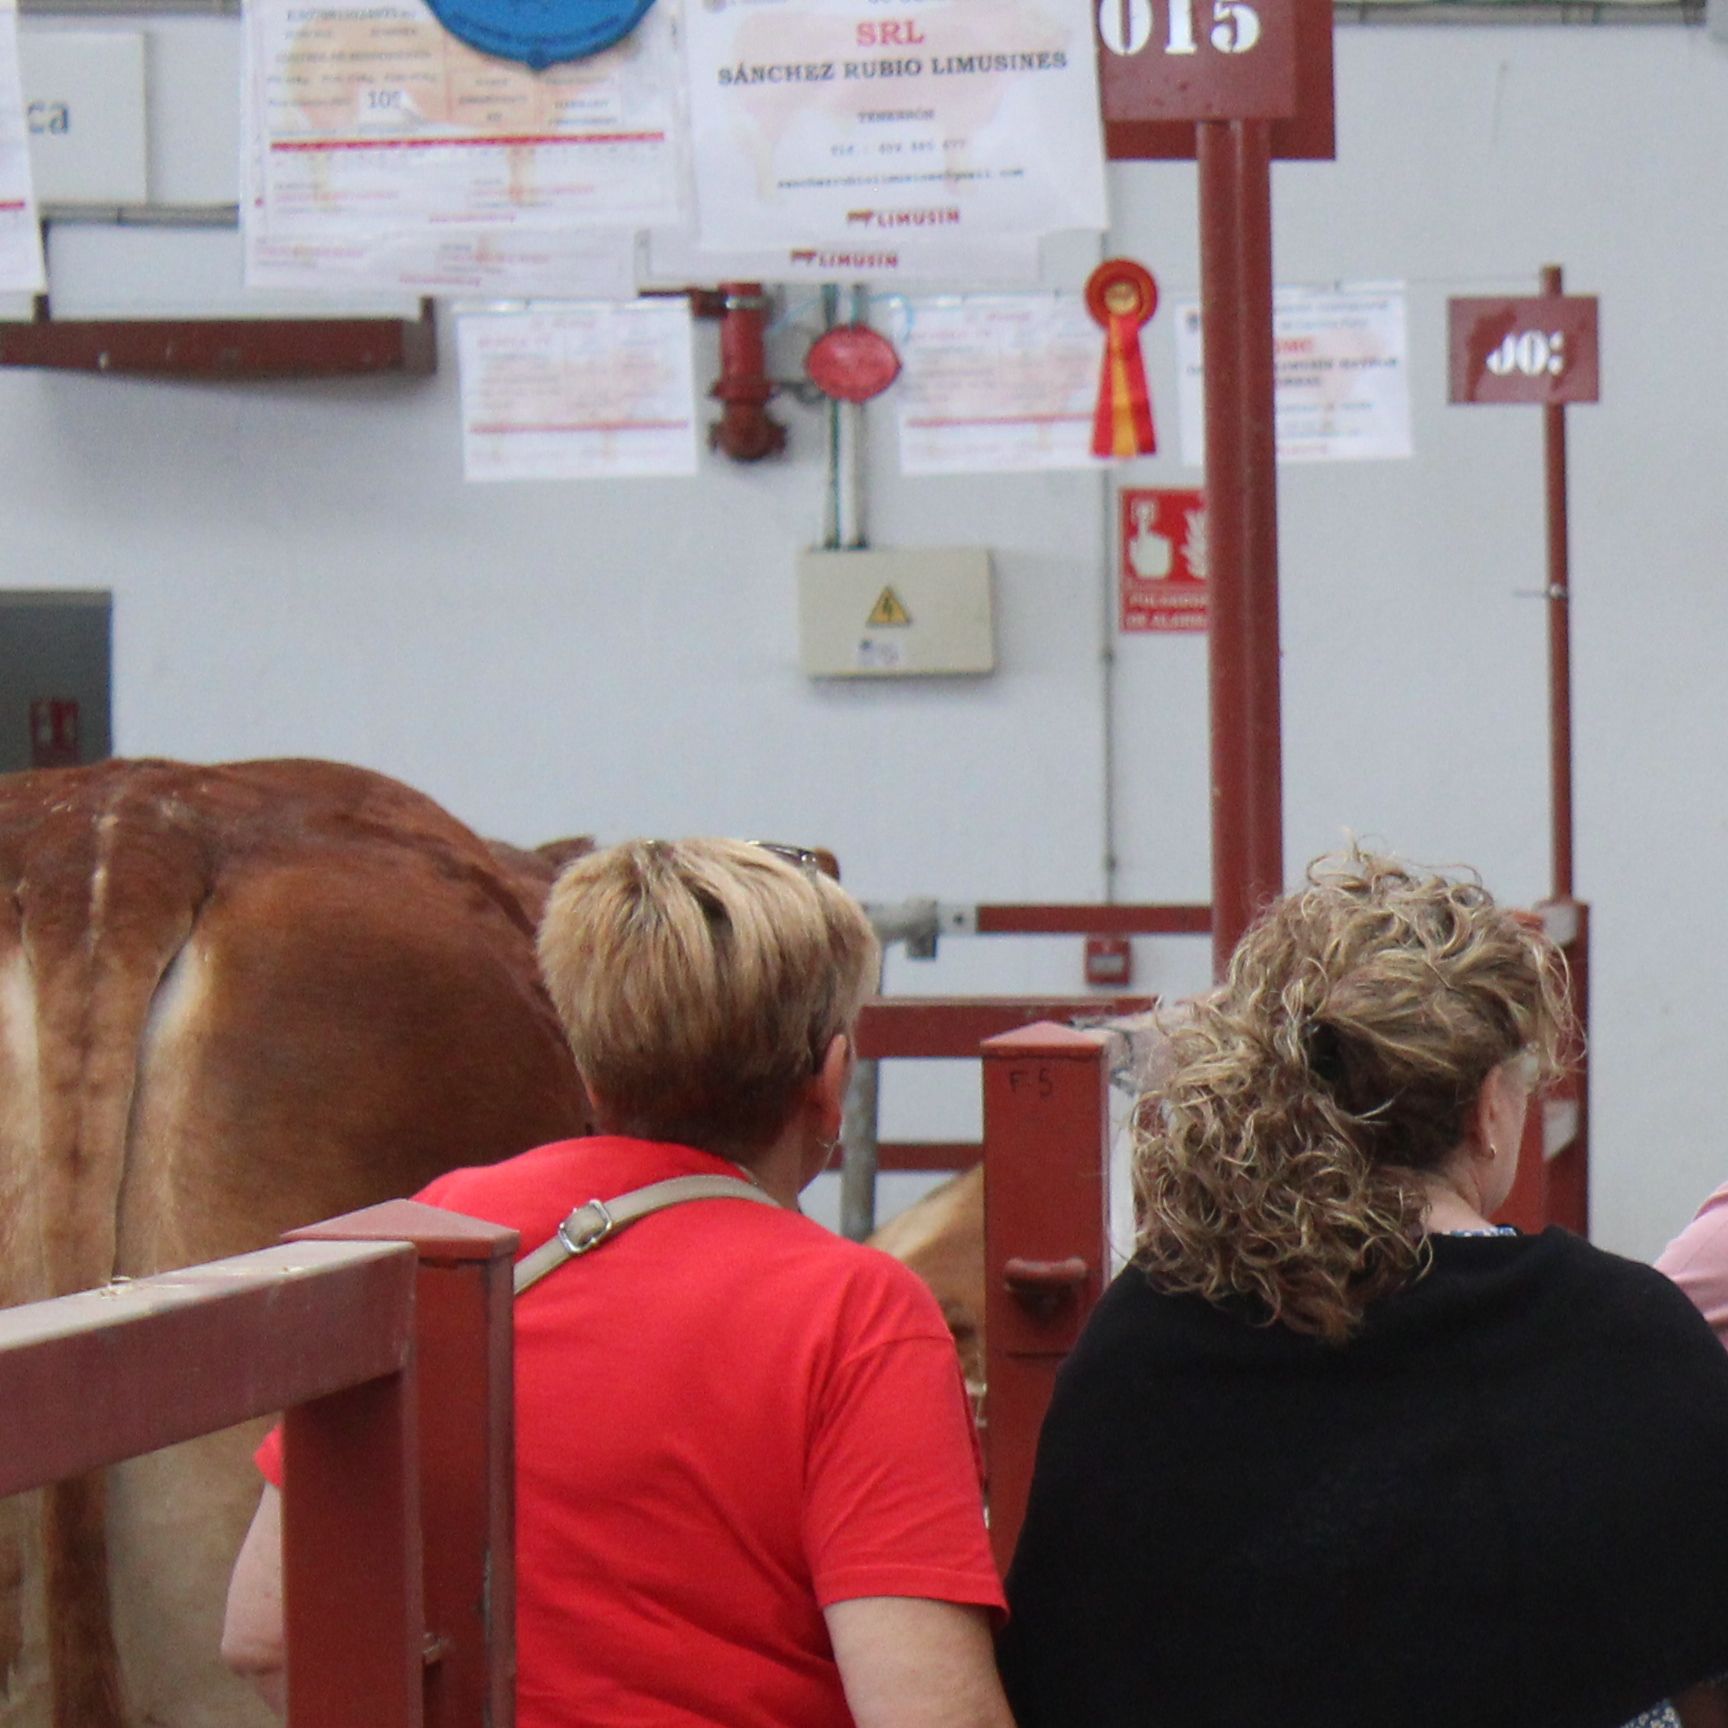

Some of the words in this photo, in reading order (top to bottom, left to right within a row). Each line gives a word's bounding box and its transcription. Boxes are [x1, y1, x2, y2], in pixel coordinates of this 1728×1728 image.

[856, 19, 925, 47] SRL
[717, 58, 835, 86] SÁNCHEZ
[843, 57, 923, 81] RUBIO
[932, 50, 1068, 76] LIMUSINES
